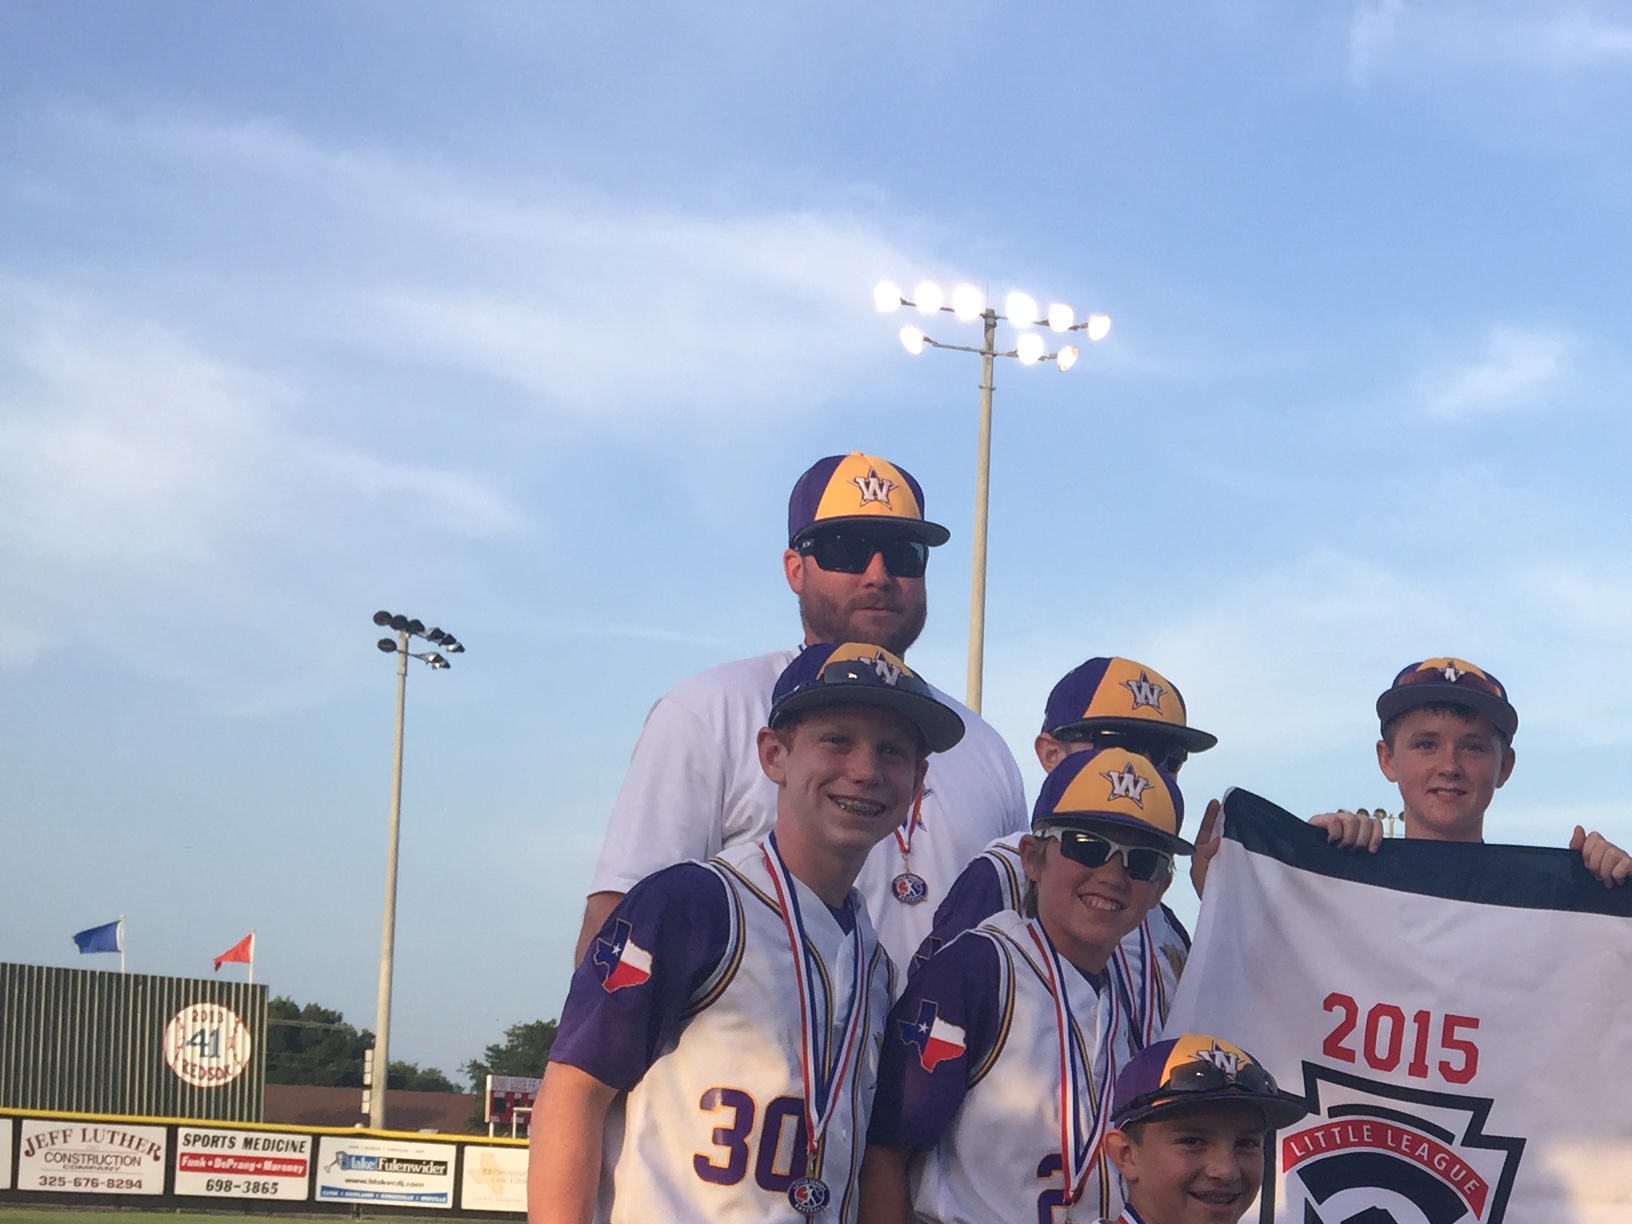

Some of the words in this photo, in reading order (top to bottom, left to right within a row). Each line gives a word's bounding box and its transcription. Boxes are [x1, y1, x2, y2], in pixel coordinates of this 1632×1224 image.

[855, 478, 892, 501] W
[1128, 681, 1161, 707] W
[1109, 772, 1147, 799] W
[186, 1027, 221, 1058] 41
[1322, 991, 1480, 1085] 2015
[24, 1128, 73, 1157] JEFF
[81, 1127, 162, 1162] LUTHER
[182, 1133, 237, 1149] SPORTS
[242, 1137, 307, 1153] MEDICINE
[693, 1085, 808, 1192] 30
[44, 1152, 141, 1167] CONSTRUCTION
[378, 1158, 446, 1175] Fulenwider
[1290, 1125, 1373, 1158] LITTLE
[1387, 1129, 1480, 1196] LEAGUE
[39, 1175, 143, 1189] 325-676-8294
[206, 1178, 279, 1194] 698-3865
